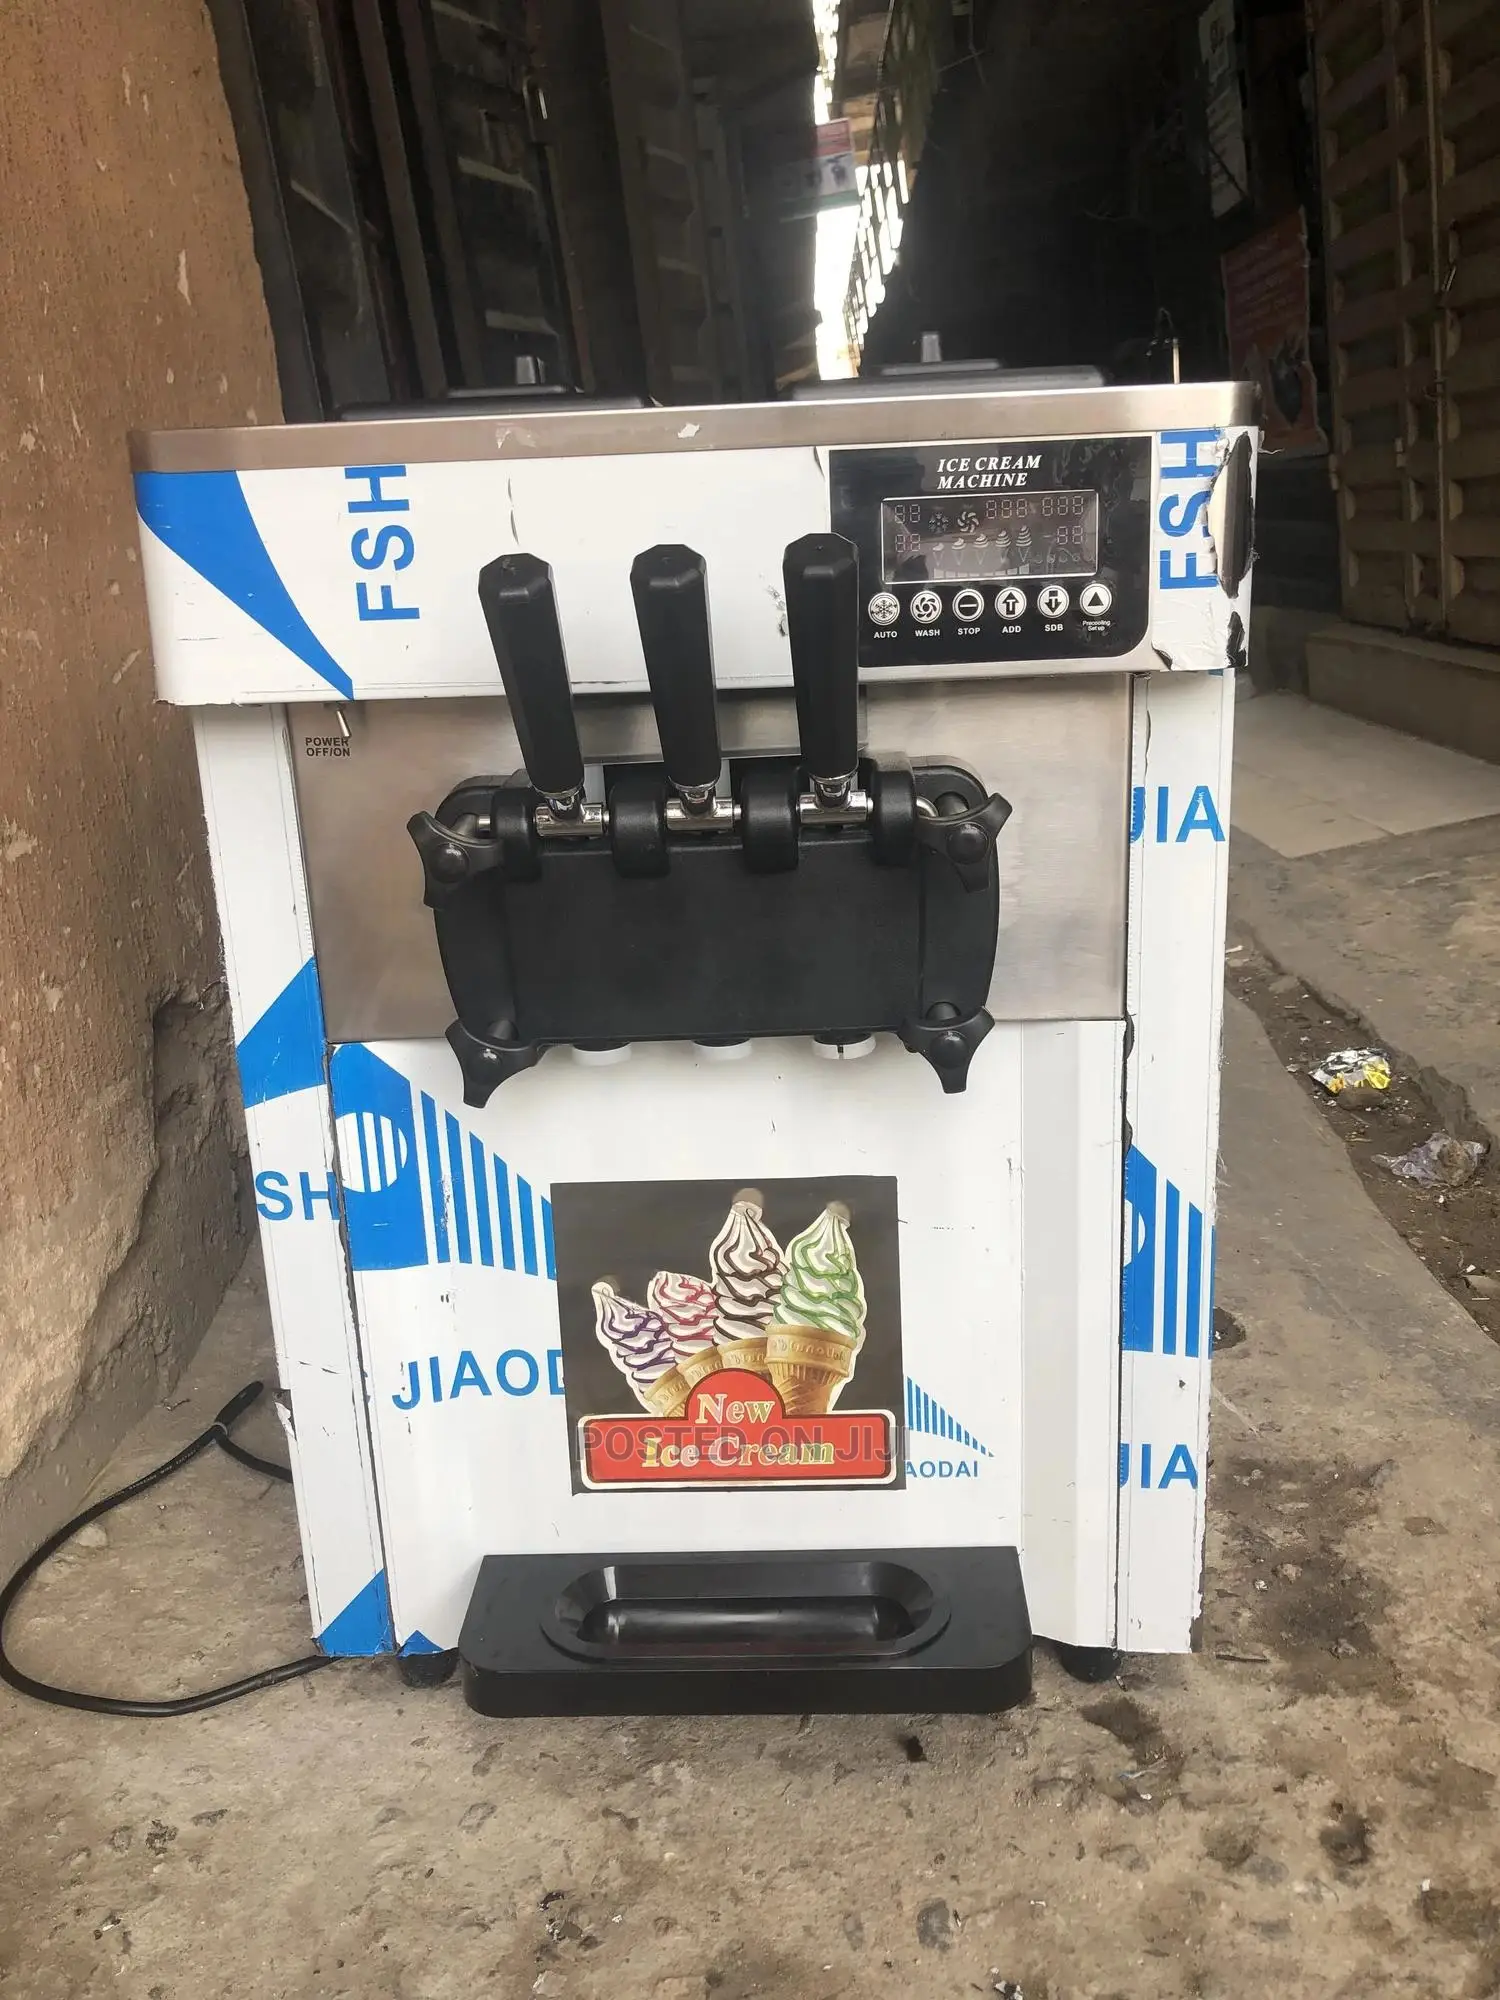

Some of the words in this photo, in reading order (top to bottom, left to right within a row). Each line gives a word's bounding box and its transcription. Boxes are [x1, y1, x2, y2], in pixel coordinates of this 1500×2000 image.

[937, 457, 971, 472] ICE
[974, 454, 1042, 471] CREAM
[937, 472, 1028, 489] MACHINE
[344, 464, 420, 621] FSH
[957, 627, 981, 635] STOP
[1002, 625, 1022, 634] ADD
[1044, 623, 1064, 632] SDB
[873, 630, 898, 639] AUTO
[915, 629, 941, 637] WASH
[305, 737, 349, 747] POWER
[306, 747, 350, 757] OFF/ON
[255, 1170, 340, 1221] SH
[694, 1393, 775, 1425] New
[641, 1436, 700, 1468] Ice
[707, 1434, 835, 1468] Cream
